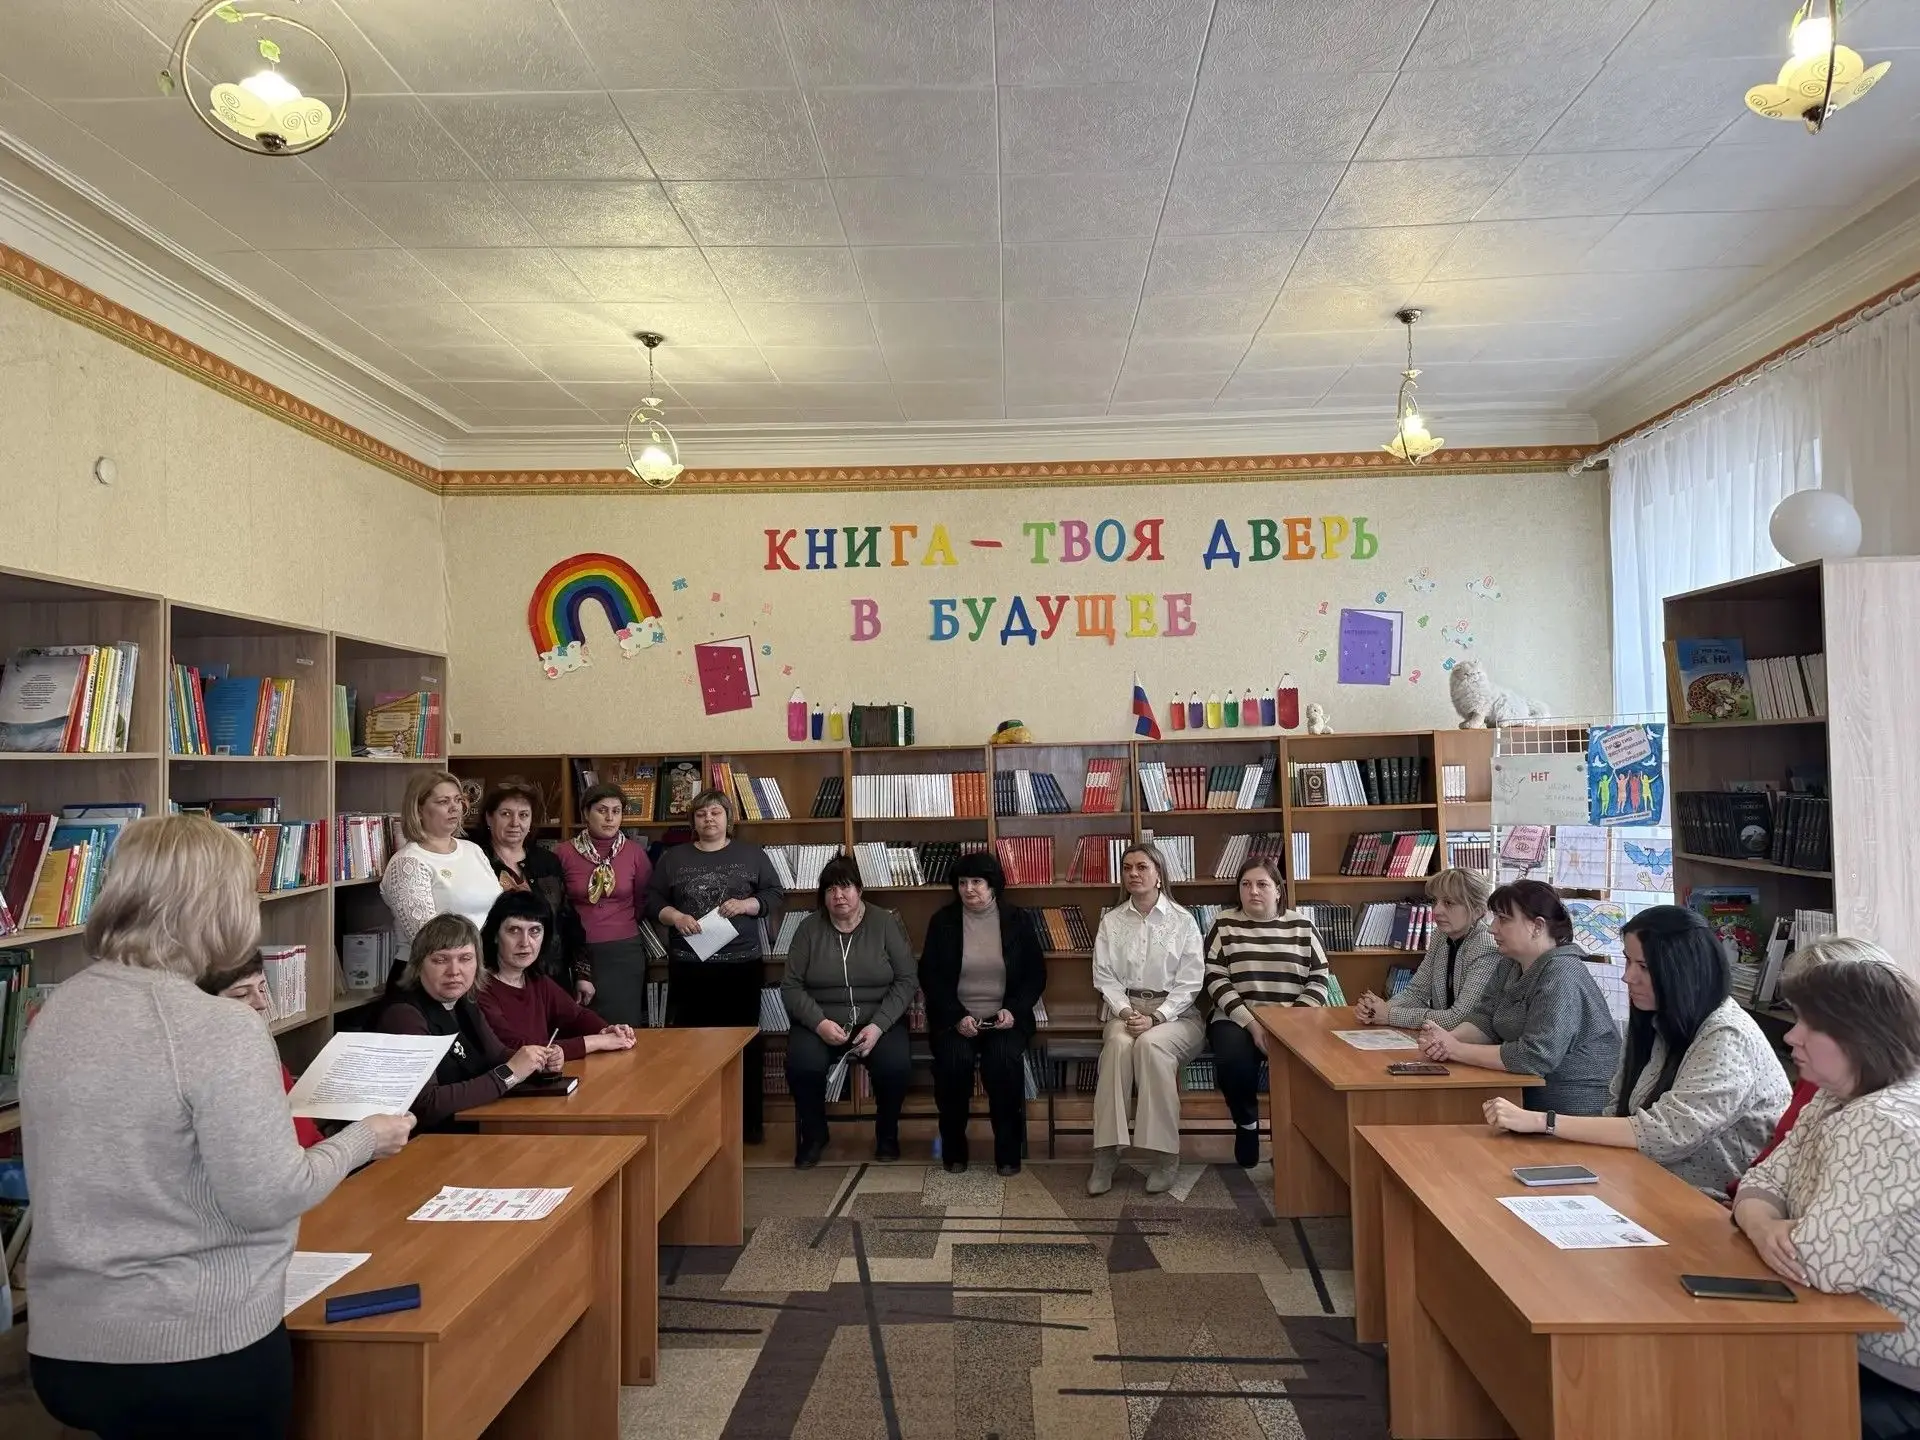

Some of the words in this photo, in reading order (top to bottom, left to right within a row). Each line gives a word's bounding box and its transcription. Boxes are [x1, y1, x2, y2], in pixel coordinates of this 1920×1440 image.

[764, 525, 959, 571] КНИГА
[1022, 518, 1165, 564] ТВОЯ
[1202, 516, 1380, 570] ДВЕРЬ
[1374, 591, 1388, 605] 6
[1318, 601, 1329, 615] 1
[851, 598, 882, 642] В
[928, 593, 1198, 646] БУДУЩЕЕ
[1408, 669, 1422, 684] 2
[1531, 772, 1549, 782] НЕТ
